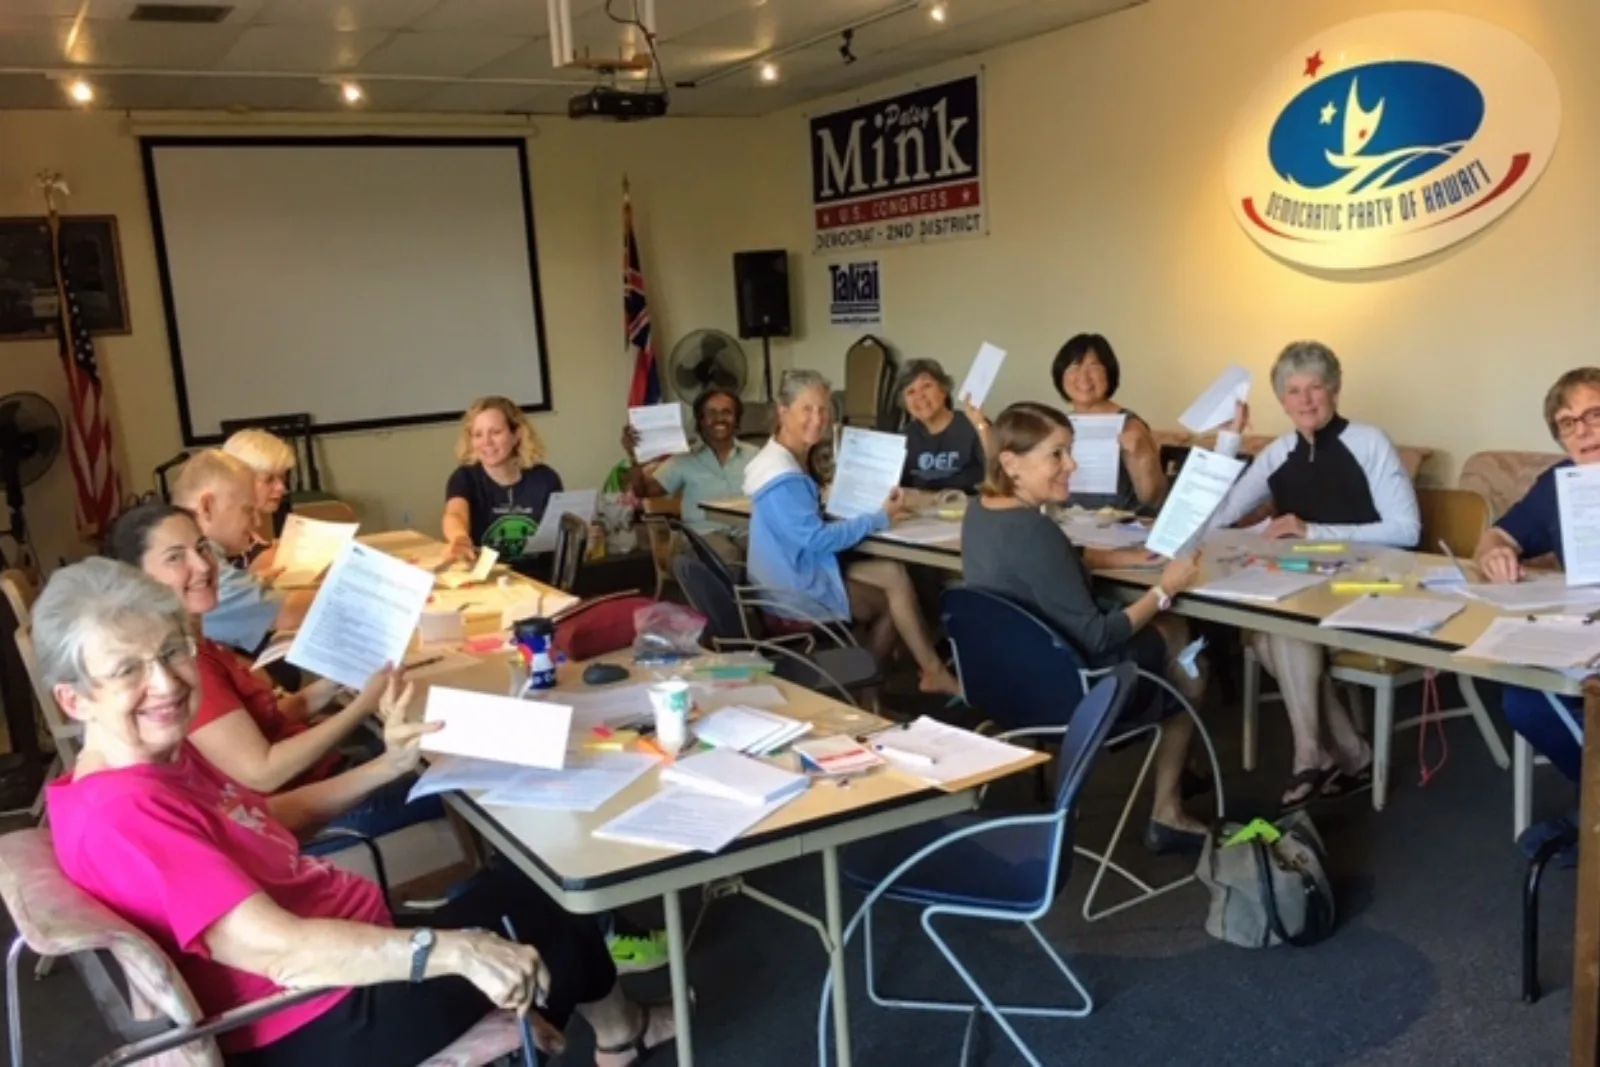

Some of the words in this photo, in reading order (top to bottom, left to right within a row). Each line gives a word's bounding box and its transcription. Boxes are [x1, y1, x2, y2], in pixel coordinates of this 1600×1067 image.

[817, 97, 971, 197] Mink
[838, 205, 867, 223] U.S.
[871, 190, 949, 218] CONGRESS
[1264, 191, 1343, 231] DEMOCRATIC
[1347, 197, 1393, 230] PARTY
[1398, 191, 1418, 221] OF
[815, 227, 875, 249] DEMOCRAT
[886, 223, 915, 241] 2ND
[919, 213, 981, 237] DISTRICT
[829, 261, 877, 301] Takai
